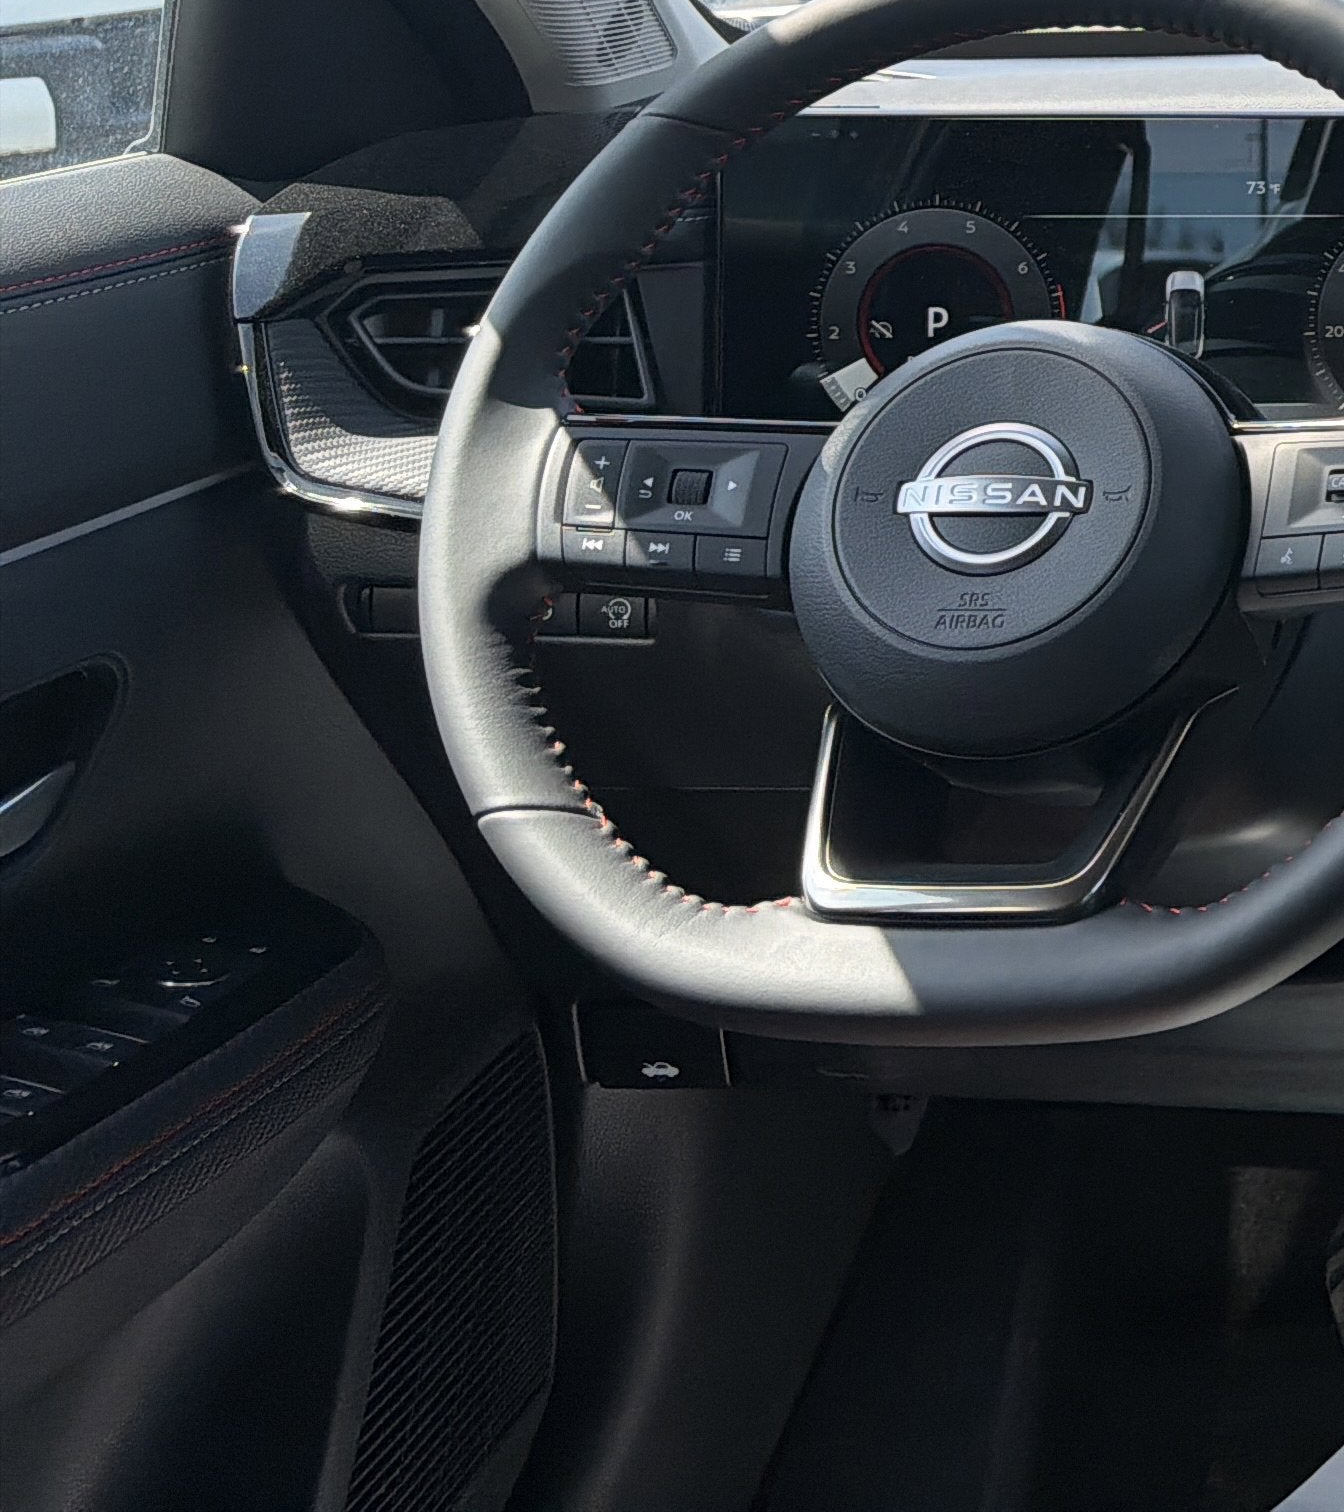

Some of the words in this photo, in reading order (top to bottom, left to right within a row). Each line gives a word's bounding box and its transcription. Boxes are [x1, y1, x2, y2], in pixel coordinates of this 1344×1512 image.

[1246, 181, 1265, 195] 73
[896, 221, 909, 234] 4
[965, 221, 976, 234] 5
[845, 261, 856, 275] 3
[1017, 261, 1028, 275] 6
[927, 307, 949, 338] P
[829, 326, 840, 340] 2
[1325, 325, 1344, 339] 20
[901, 481, 1087, 509] NISSAN
[674, 511, 694, 521] OK
[957, 592, 989, 608] SRS
[601, 605, 626, 613] AUTO
[609, 620, 629, 628] OFF
[934, 613, 1005, 630] AIRBAG
